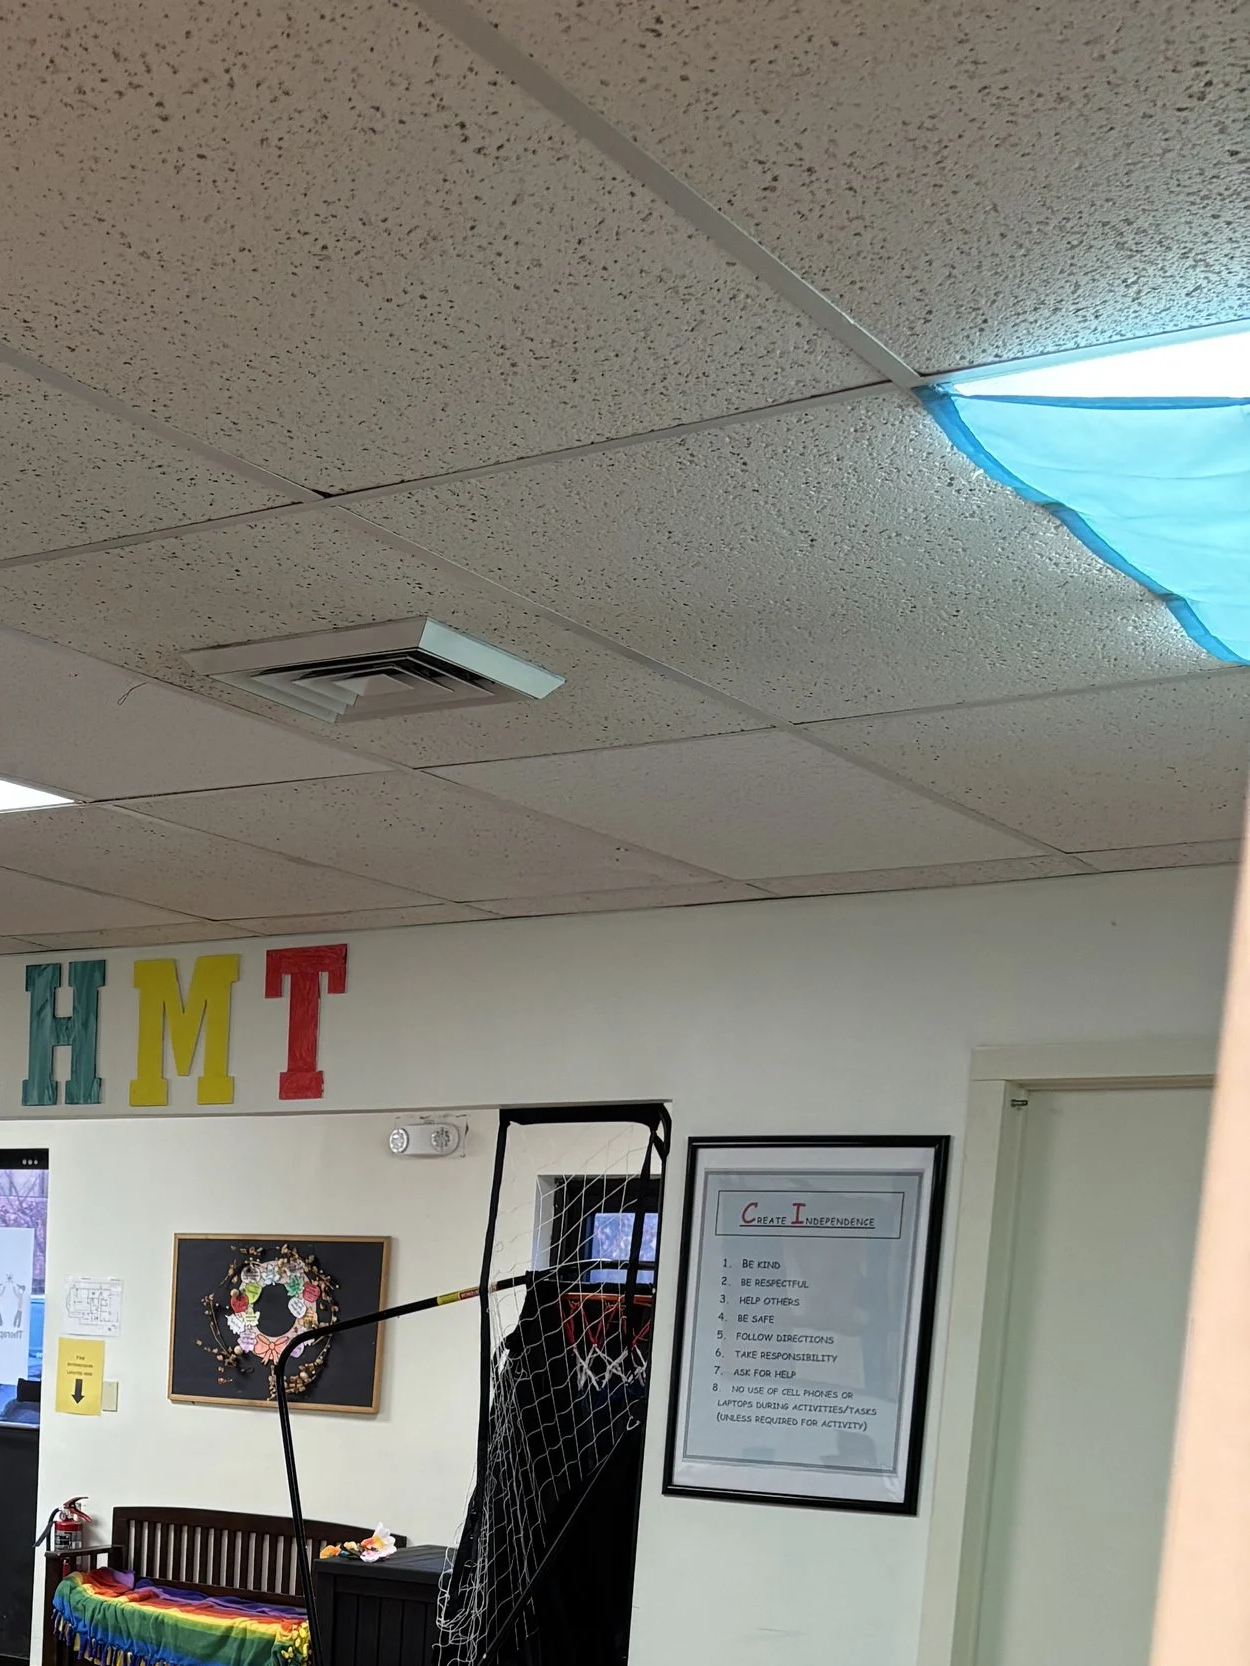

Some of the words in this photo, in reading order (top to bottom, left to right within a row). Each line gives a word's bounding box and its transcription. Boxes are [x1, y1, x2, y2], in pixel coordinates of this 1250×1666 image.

[742, 1259, 754, 1268] BE
[758, 1261, 780, 1269] KIND
[741, 1278, 751, 1286] BE
[755, 1279, 809, 1288] RESPECTFUL
[740, 1296, 760, 1305] HELP
[763, 1298, 800, 1306] OTHERS
[738, 1314, 748, 1322] BE
[752, 1315, 774, 1324] SAFE
[736, 1332, 773, 1342] FOLLOW
[776, 1334, 834, 1344] DIRECTIONS
[735, 1350, 757, 1359] TAKE
[760, 1351, 837, 1363] RESPONSIBILITY
[734, 1369, 750, 1377] ASK
[754, 1369, 771, 1378] FOR
[775, 1370, 796, 1379] HELP
[732, 1385, 744, 1393] NO
[748, 1386, 764, 1394] USE
[767, 1387, 778, 1395] OF
[782, 1388, 800, 1396] CELL
[804, 1389, 838, 1398] PHONES
[842, 1391, 853, 1399] OR
[718, 1399, 752, 1408] LAPTOPS
[756, 1401, 788, 1410] DURING
[717, 1412, 751, 1423] (UNLESS
[755, 1415, 798, 1426] REQUIRED
[801, 1418, 817, 1427] FOR
[821, 1420, 867, 1431] ACTIVITY)
